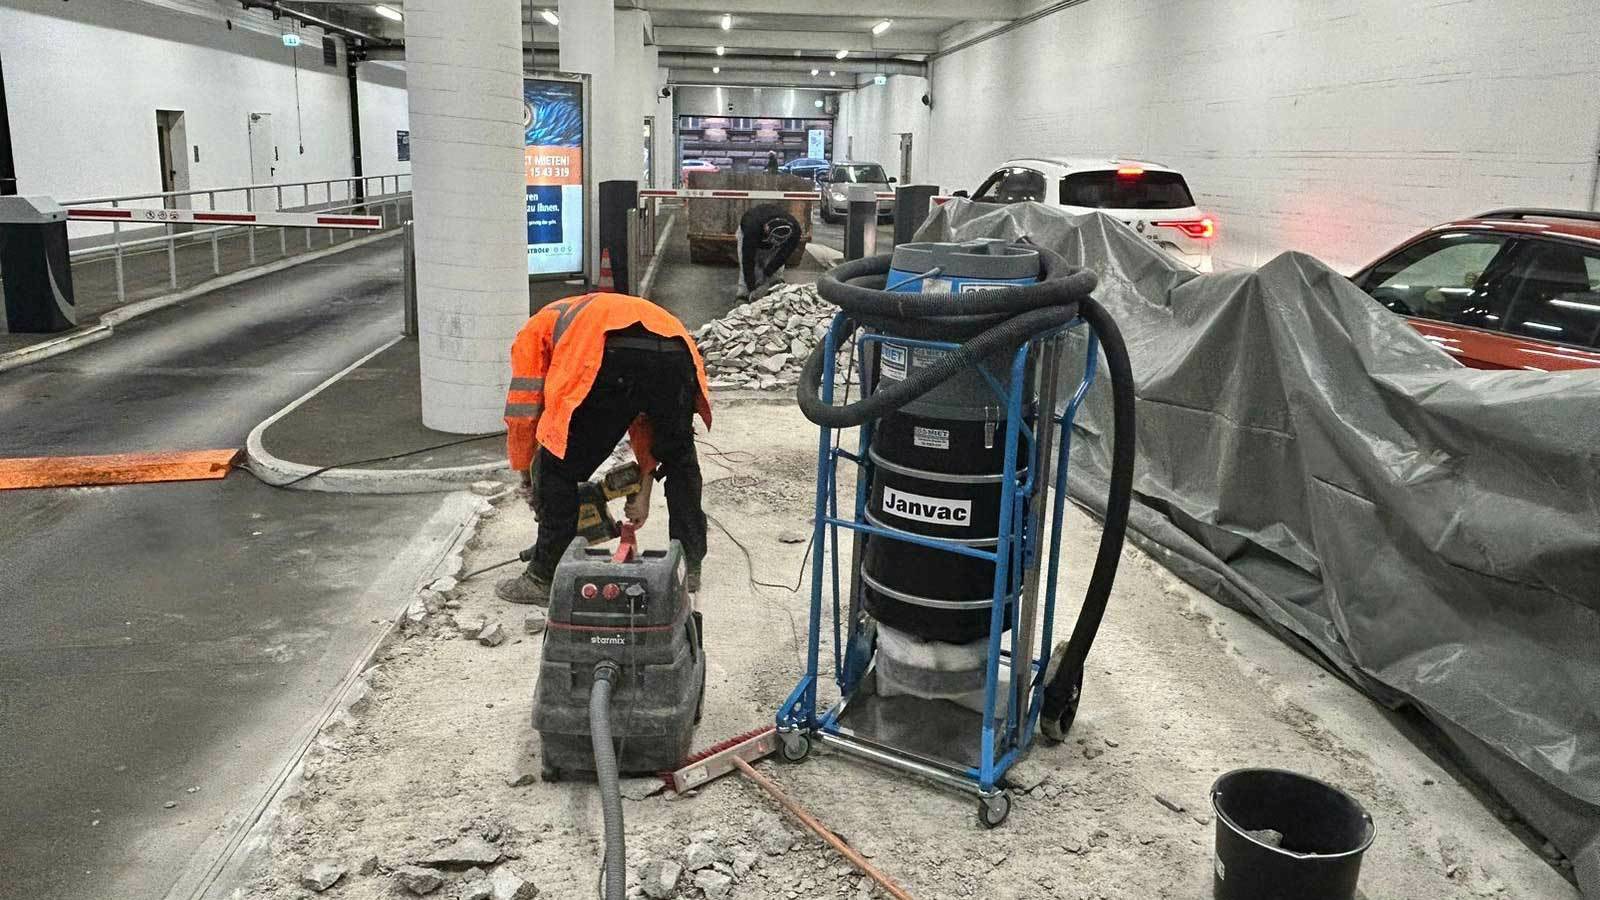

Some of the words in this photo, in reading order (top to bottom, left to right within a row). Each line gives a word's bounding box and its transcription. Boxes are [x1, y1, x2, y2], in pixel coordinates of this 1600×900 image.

[535, 155, 569, 166] MIETEN!
[885, 493, 967, 521] Janvac
[591, 634, 625, 645] starmix
